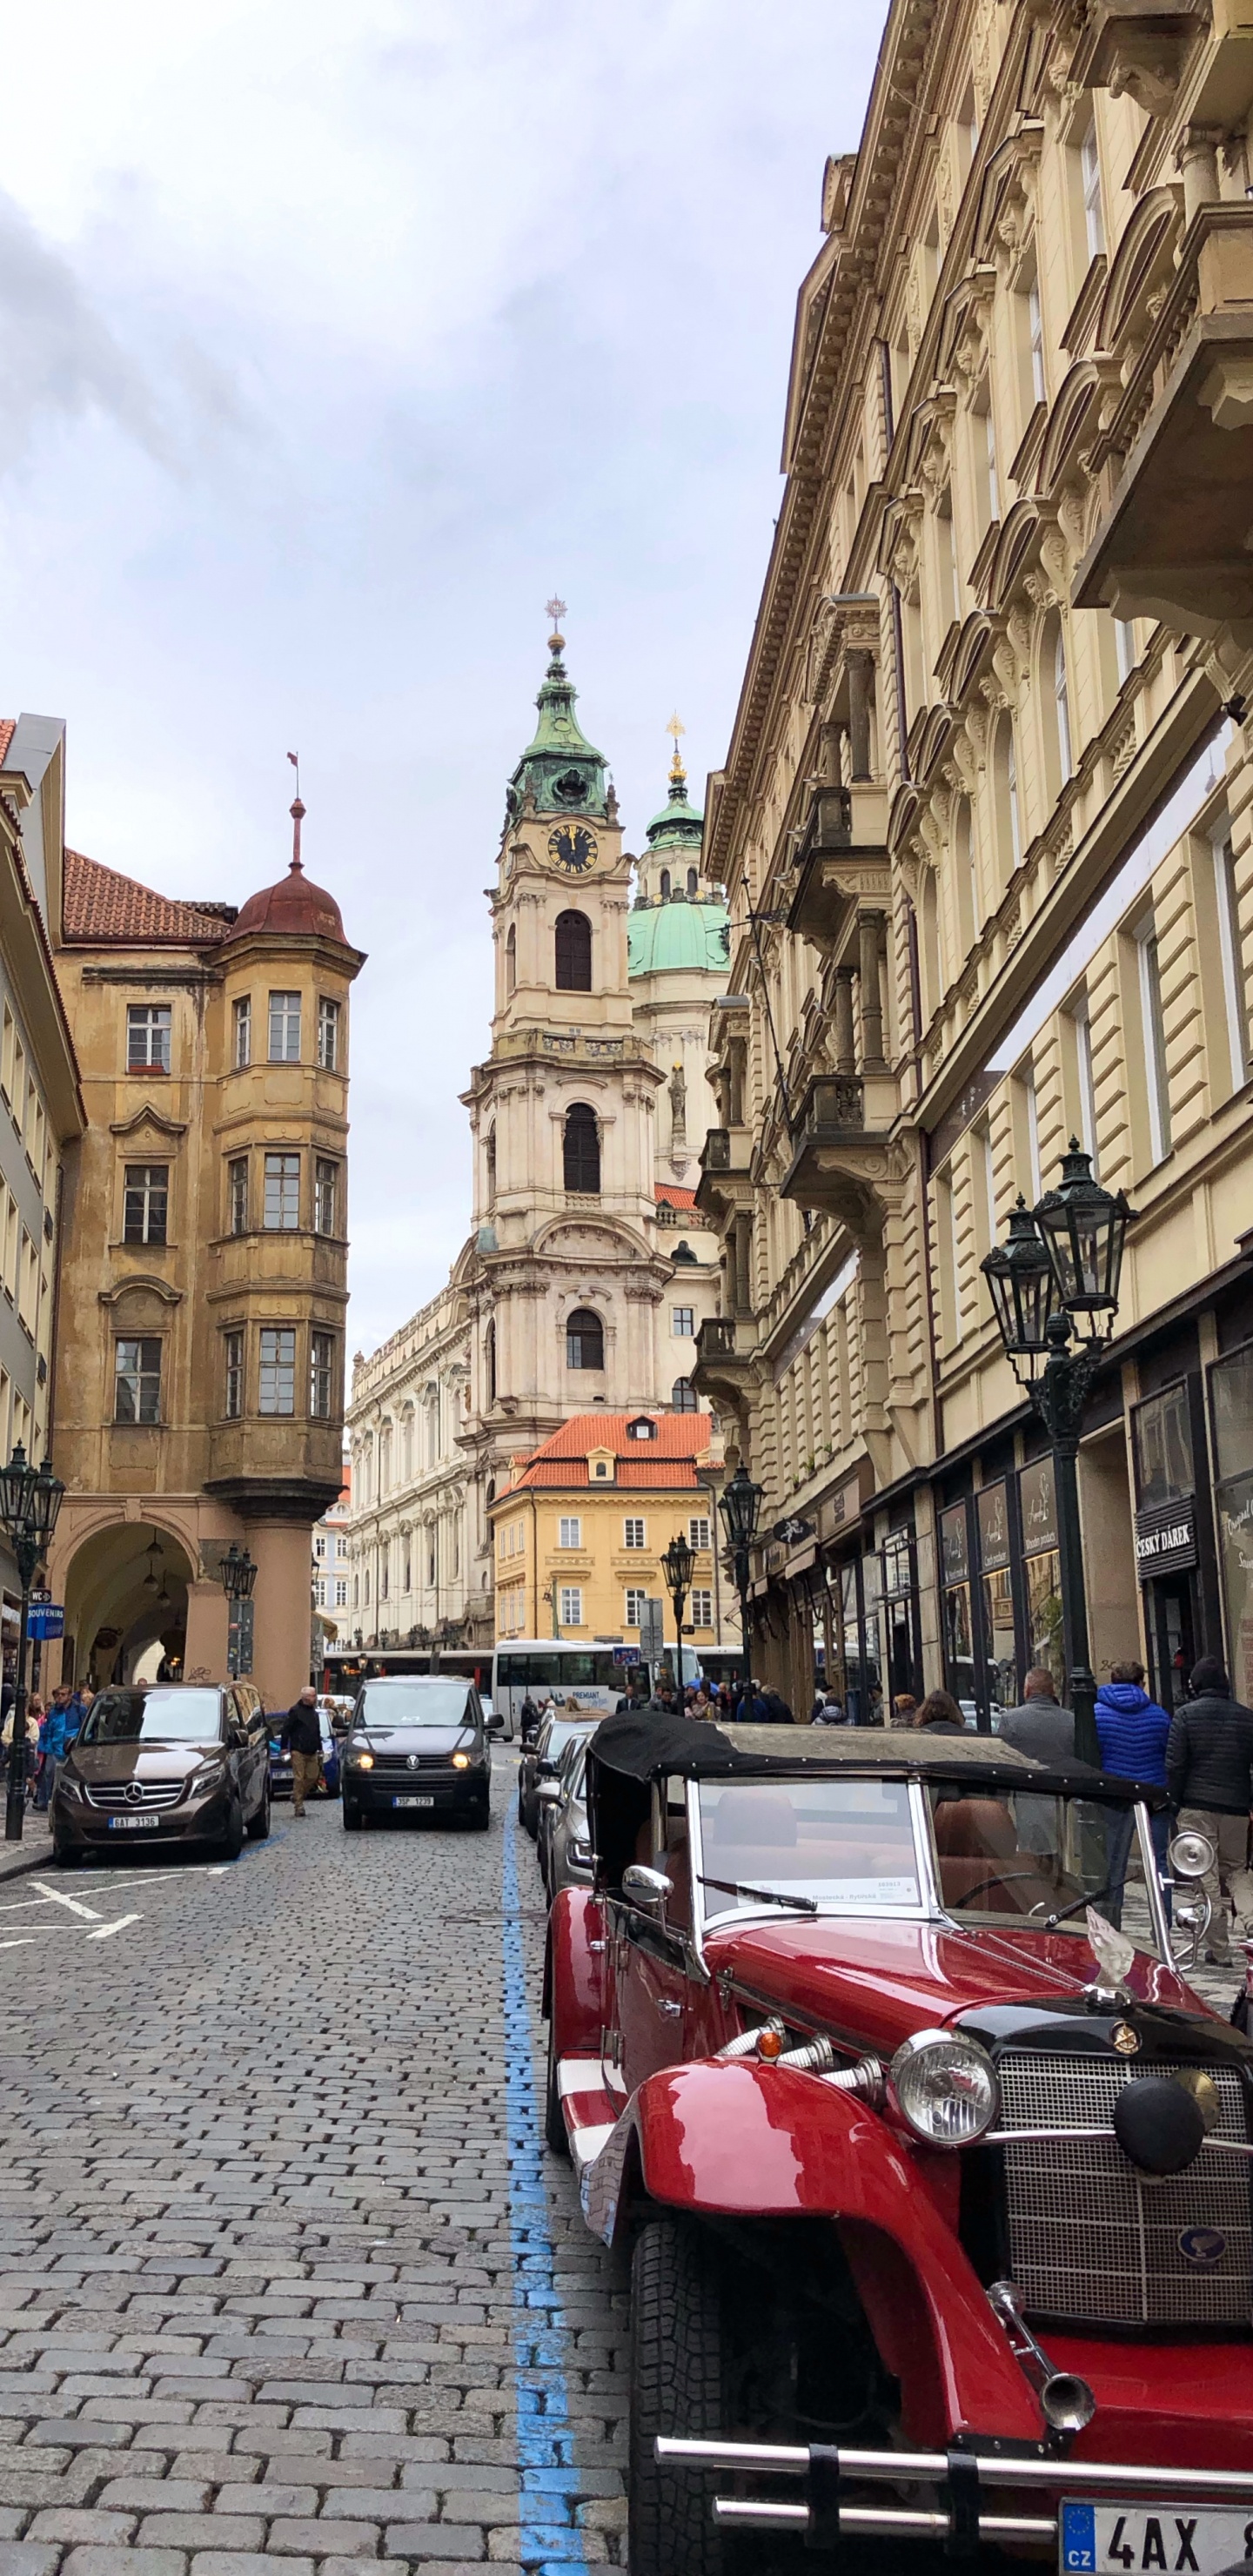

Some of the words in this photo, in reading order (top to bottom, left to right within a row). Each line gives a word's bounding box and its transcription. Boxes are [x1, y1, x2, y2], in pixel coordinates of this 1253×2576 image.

[1136, 1528, 1161, 1559] ČESKÝ
[1161, 1524, 1190, 1551] DÁREK
[32, 1592, 42, 1600] WC
[28, 1608, 64, 1619] SOUVENIRS
[115, 1818, 130, 1828] 6AT
[136, 1817, 155, 1827] 3136
[1108, 2515, 1200, 2571] 4AX
[1068, 2550, 1091, 2566] CZ
